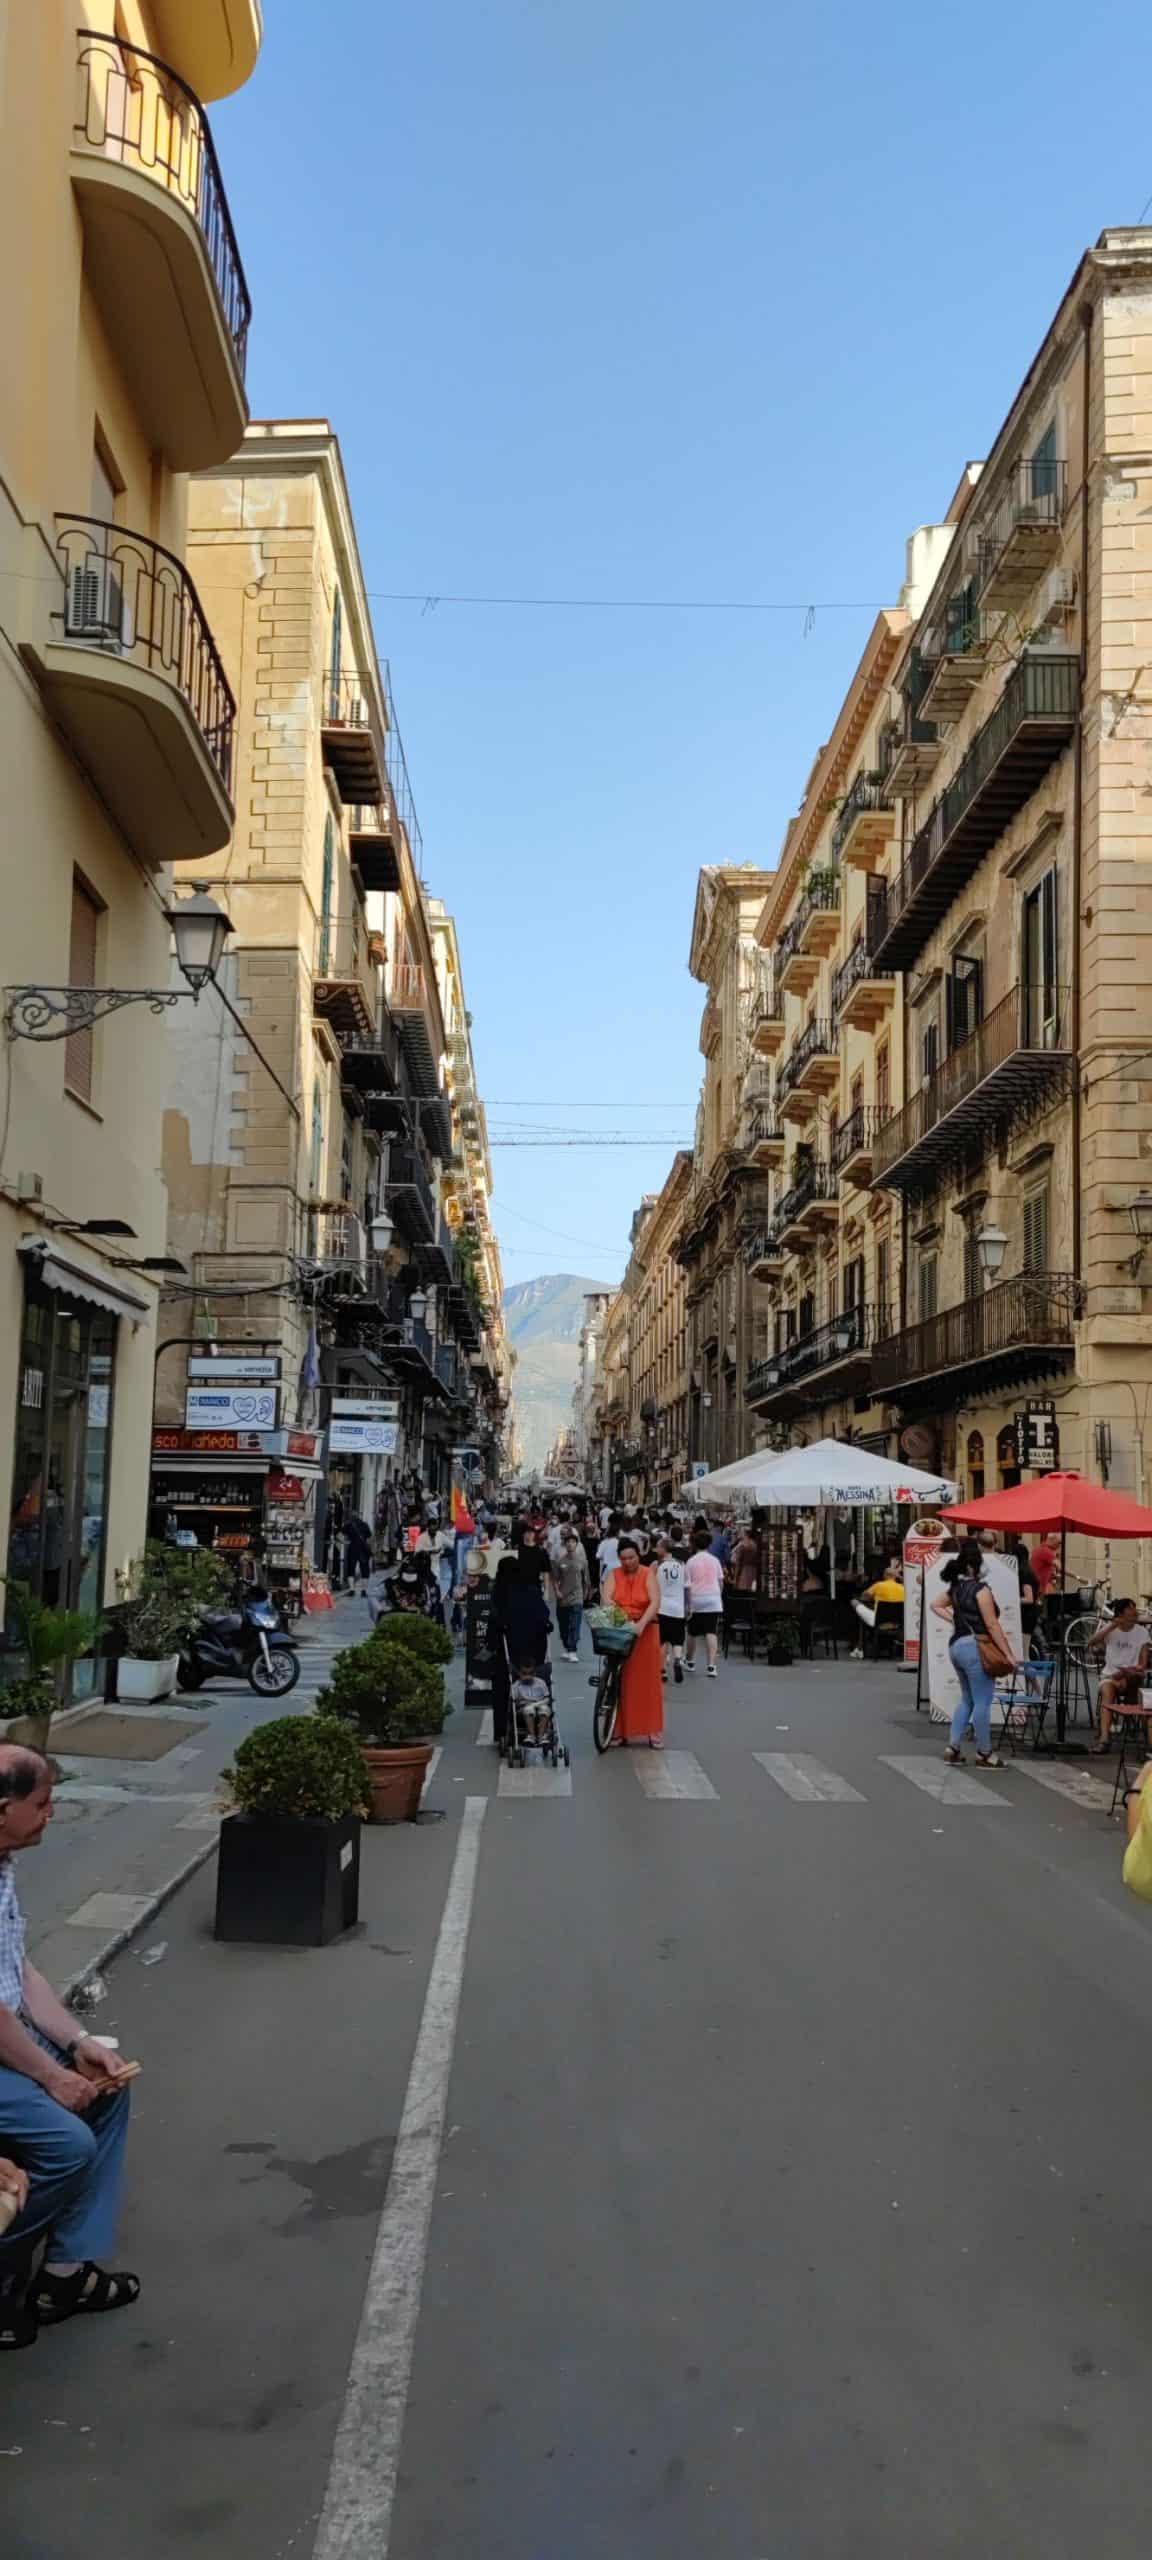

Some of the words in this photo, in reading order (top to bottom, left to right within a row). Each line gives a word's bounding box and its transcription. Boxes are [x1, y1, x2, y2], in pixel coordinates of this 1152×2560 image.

[1030, 1402, 1052, 1410] BAR
[835, 1487, 876, 1502] MESSINA
[663, 1567, 679, 1581] 10
